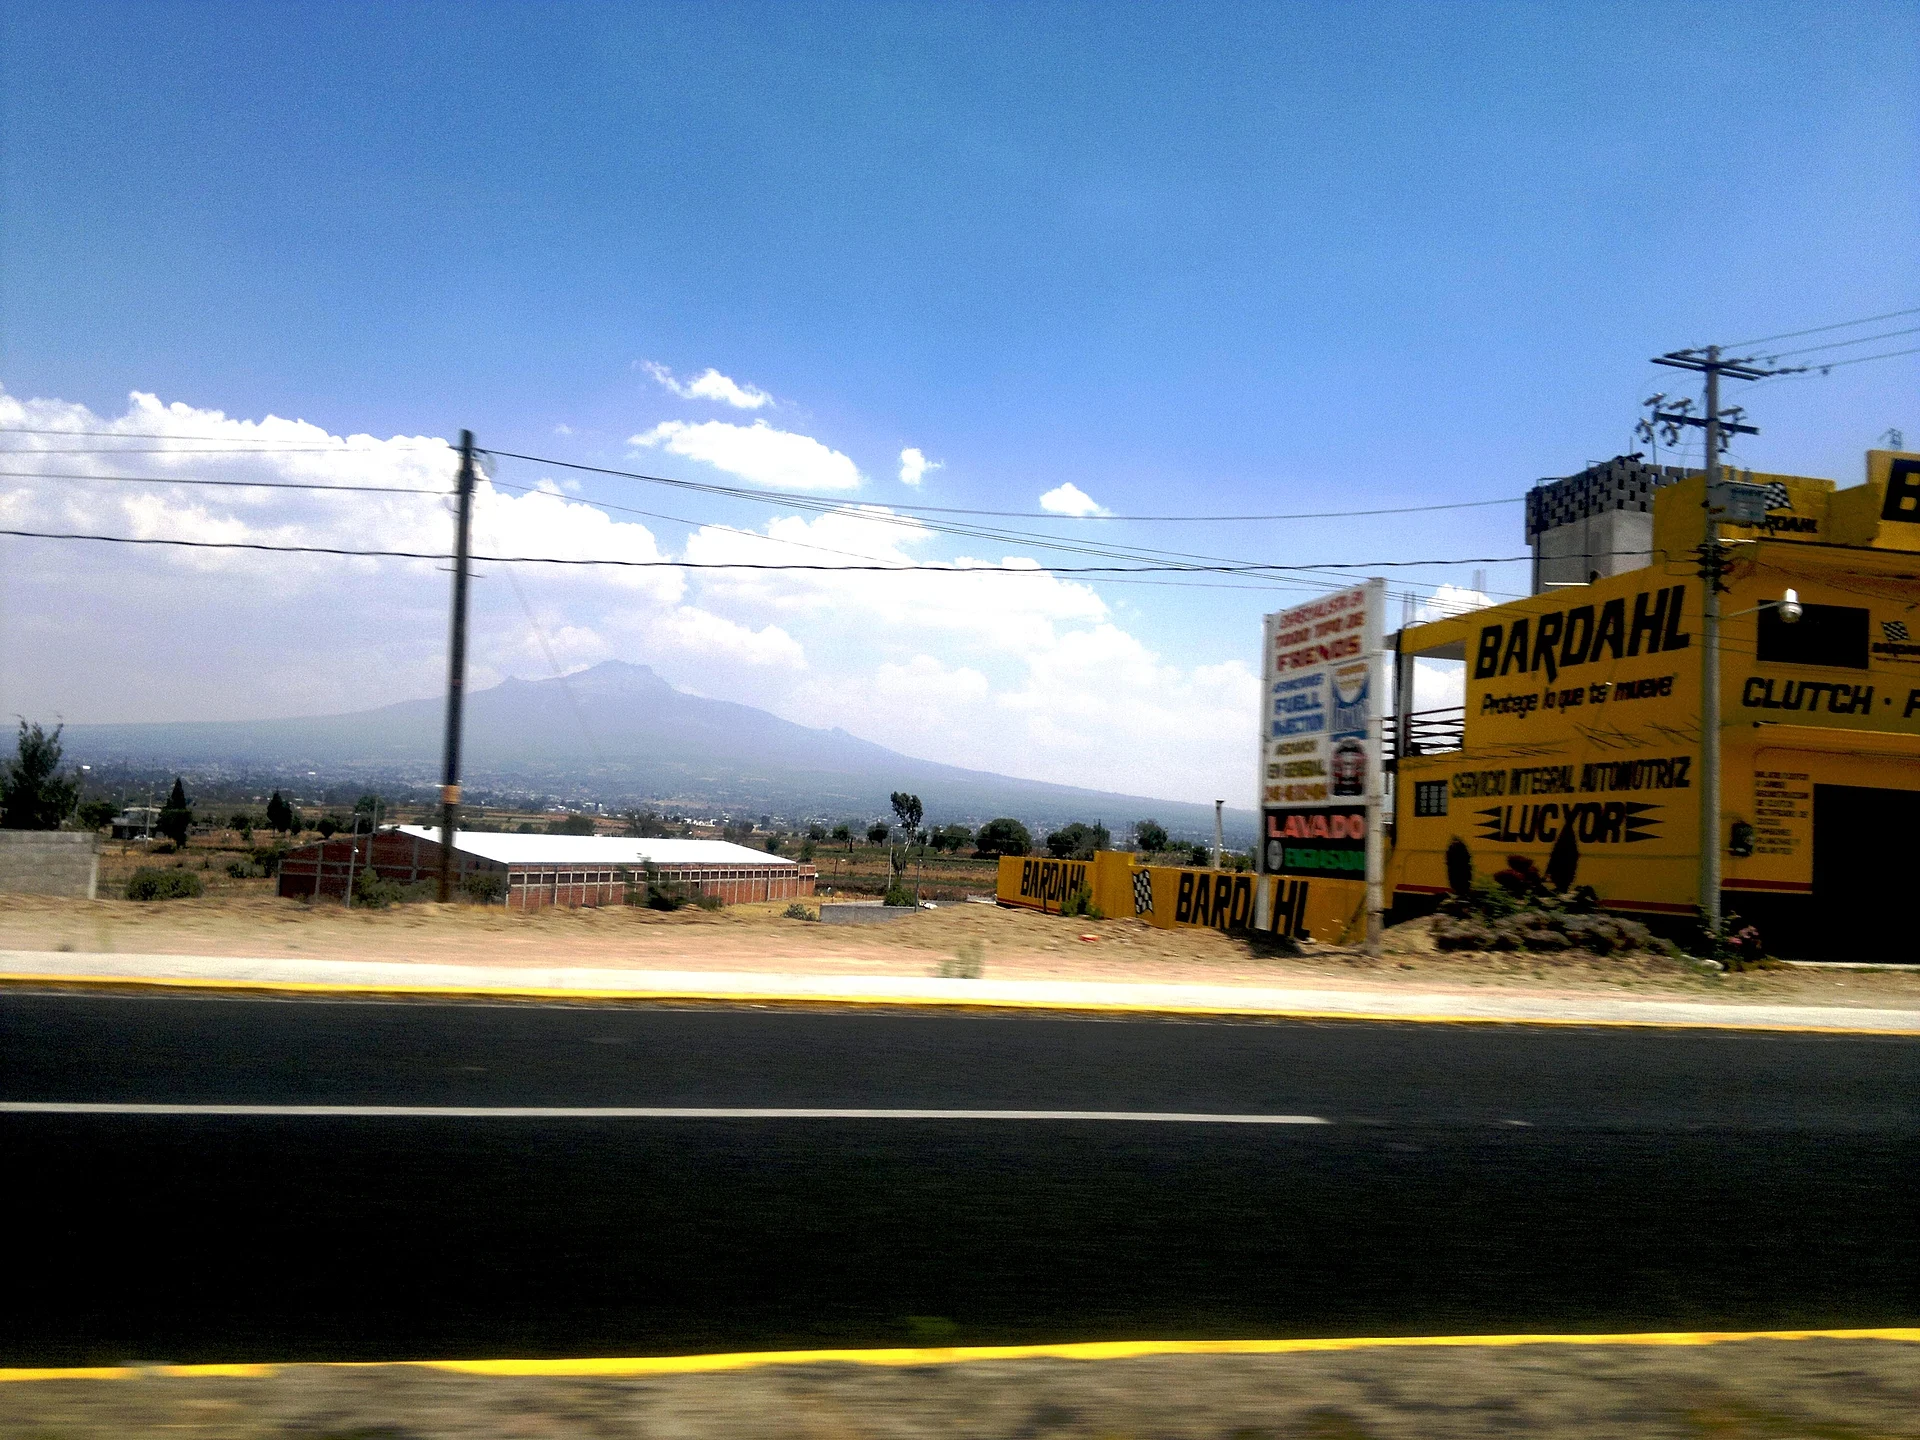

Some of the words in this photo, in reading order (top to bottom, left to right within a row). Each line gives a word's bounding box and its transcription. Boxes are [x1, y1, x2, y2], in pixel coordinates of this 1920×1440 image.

[1277, 634, 1361, 672] FRENOS
[1474, 584, 1690, 684] BARDAHL
[1481, 693, 1538, 719] Protege
[1613, 675, 1674, 701] mueve
[1742, 676, 1874, 715] CLUTCH
[1579, 756, 1691, 793] AUTOMOTRIZ
[1267, 813, 1366, 840] LAVADO
[1175, 871, 1311, 941] BARDHL
